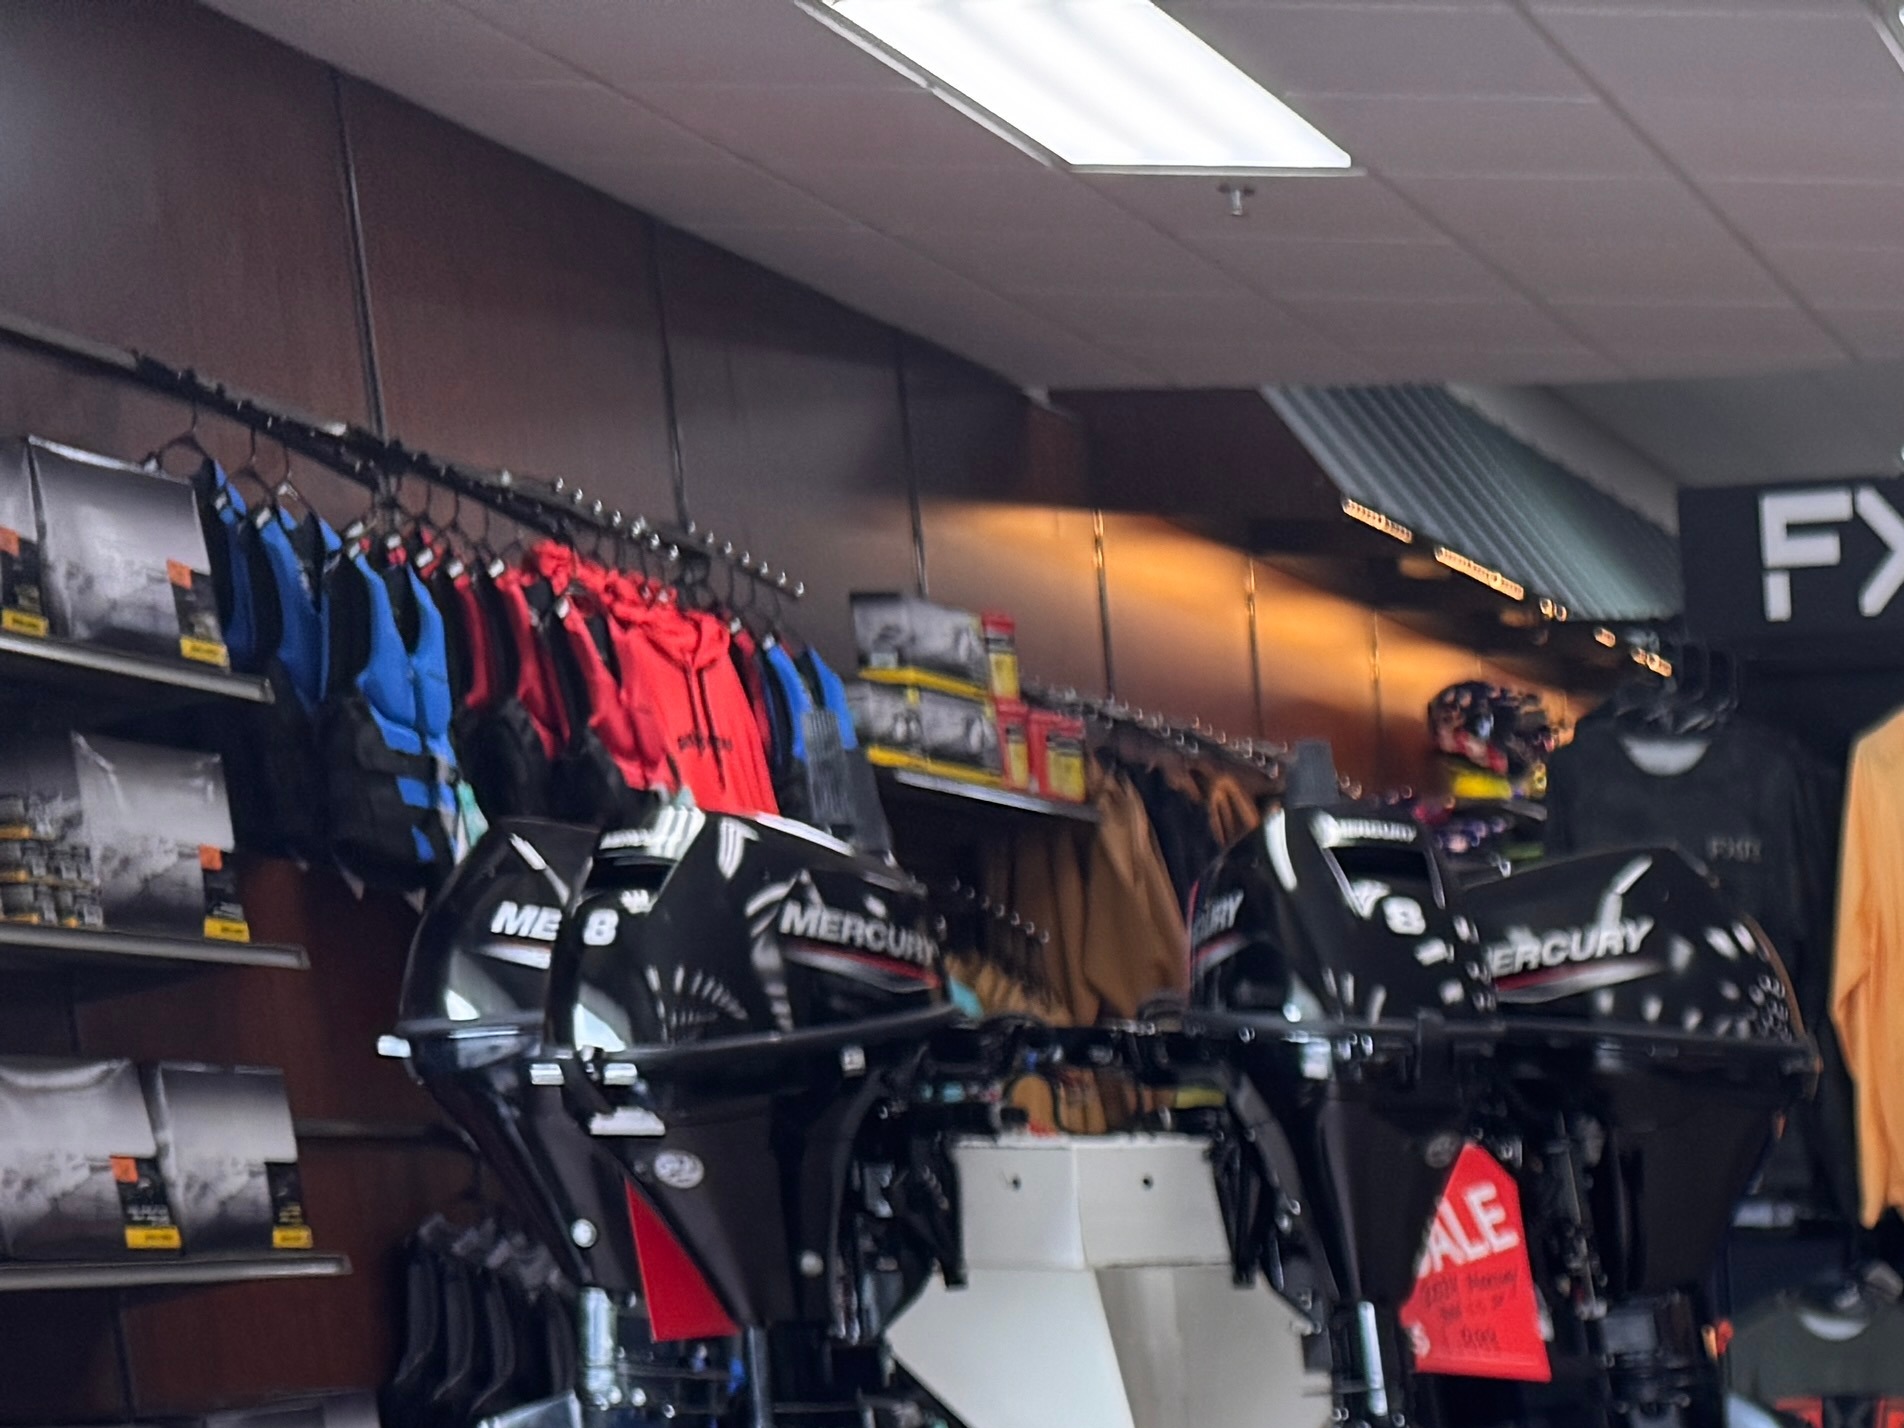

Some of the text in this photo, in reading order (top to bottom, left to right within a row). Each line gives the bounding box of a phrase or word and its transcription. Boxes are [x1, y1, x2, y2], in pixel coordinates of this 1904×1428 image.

[582, 908, 619, 946] 8
[780, 900, 940, 966] MERCURY
[1383, 896, 1427, 935] 8
[1488, 915, 1655, 977] ERCURY
[1417, 1182, 1521, 1278] ALE
